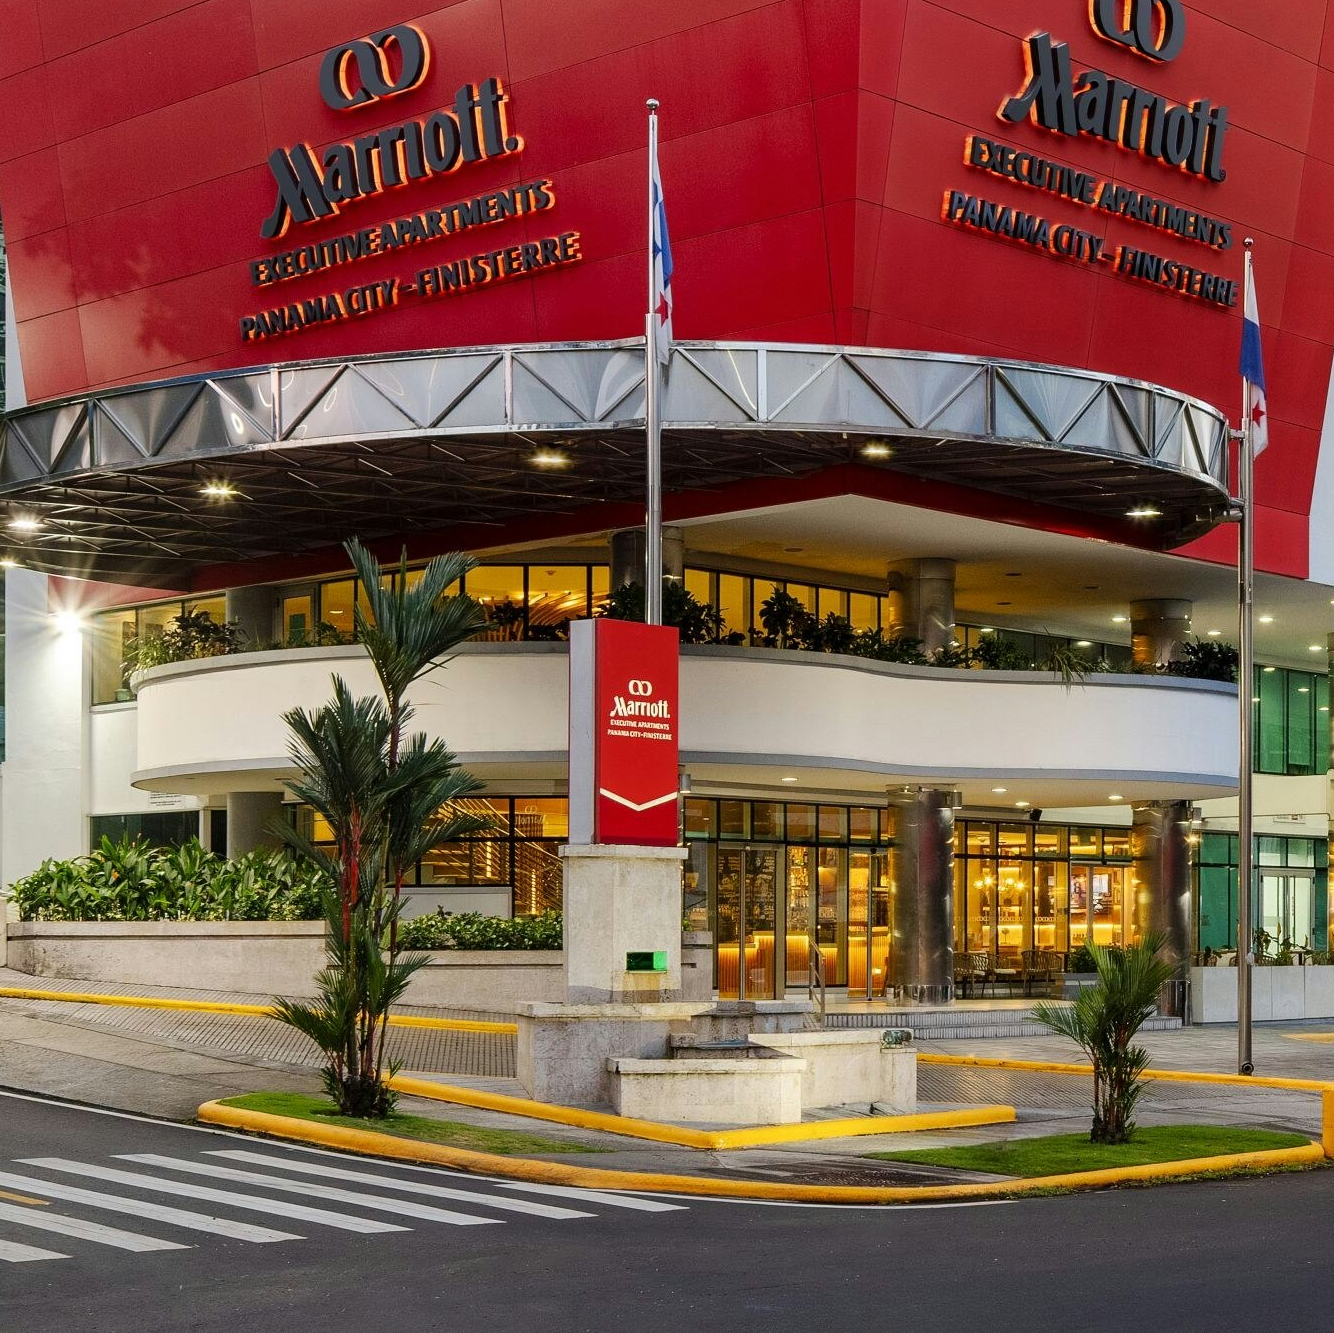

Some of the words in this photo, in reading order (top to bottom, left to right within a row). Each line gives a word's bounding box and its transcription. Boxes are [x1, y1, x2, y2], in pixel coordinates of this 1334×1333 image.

[997, 31, 1228, 182] Marriott
[260, 77, 521, 238] Marriott
[944, 189, 1050, 250] PANAMA
[966, 135, 1096, 206] EXECUTIVE
[1098, 180, 1234, 251] APARTMENTS
[251, 228, 378, 286] EXECUTIVE
[378, 179, 554, 251] APARTMENTS
[240, 292, 344, 342] PANAMA
[607, 729, 629, 737] PANAMA
[609, 695, 671, 719] Marriott
[610, 719, 637, 728] EXECUTIVE
[637, 721, 670, 730] APARTMENTS
